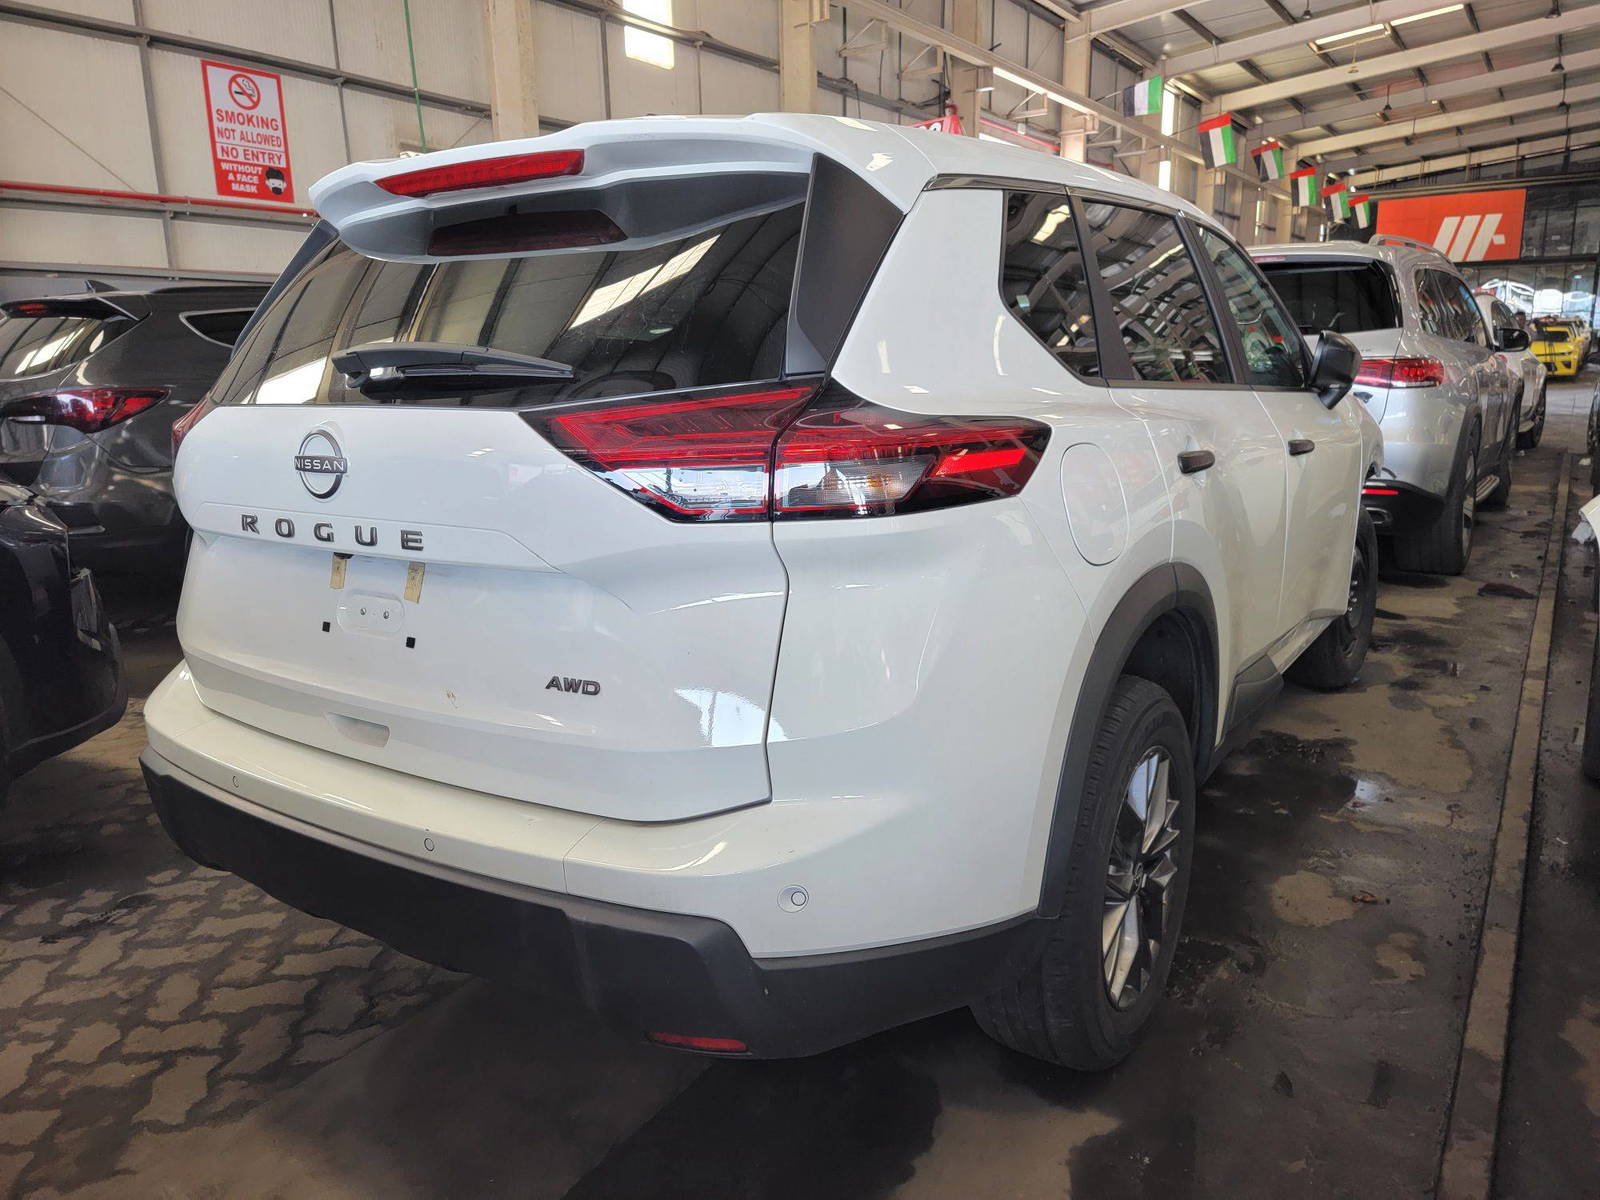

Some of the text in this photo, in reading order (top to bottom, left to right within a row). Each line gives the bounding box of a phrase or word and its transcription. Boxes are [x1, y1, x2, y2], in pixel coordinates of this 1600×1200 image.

[216, 108, 279, 131] SMOKING
[216, 126, 282, 148] NOT ALLOWED
[220, 146, 282, 165] NO ENTRY
[220, 162, 263, 174] WITHOUT
[231, 182, 258, 193] MASK
[237, 174, 259, 184] FACE
[294, 457, 344, 471] NISSAN
[241, 514, 424, 551] ROGUE
[545, 676, 600, 696] AWD
